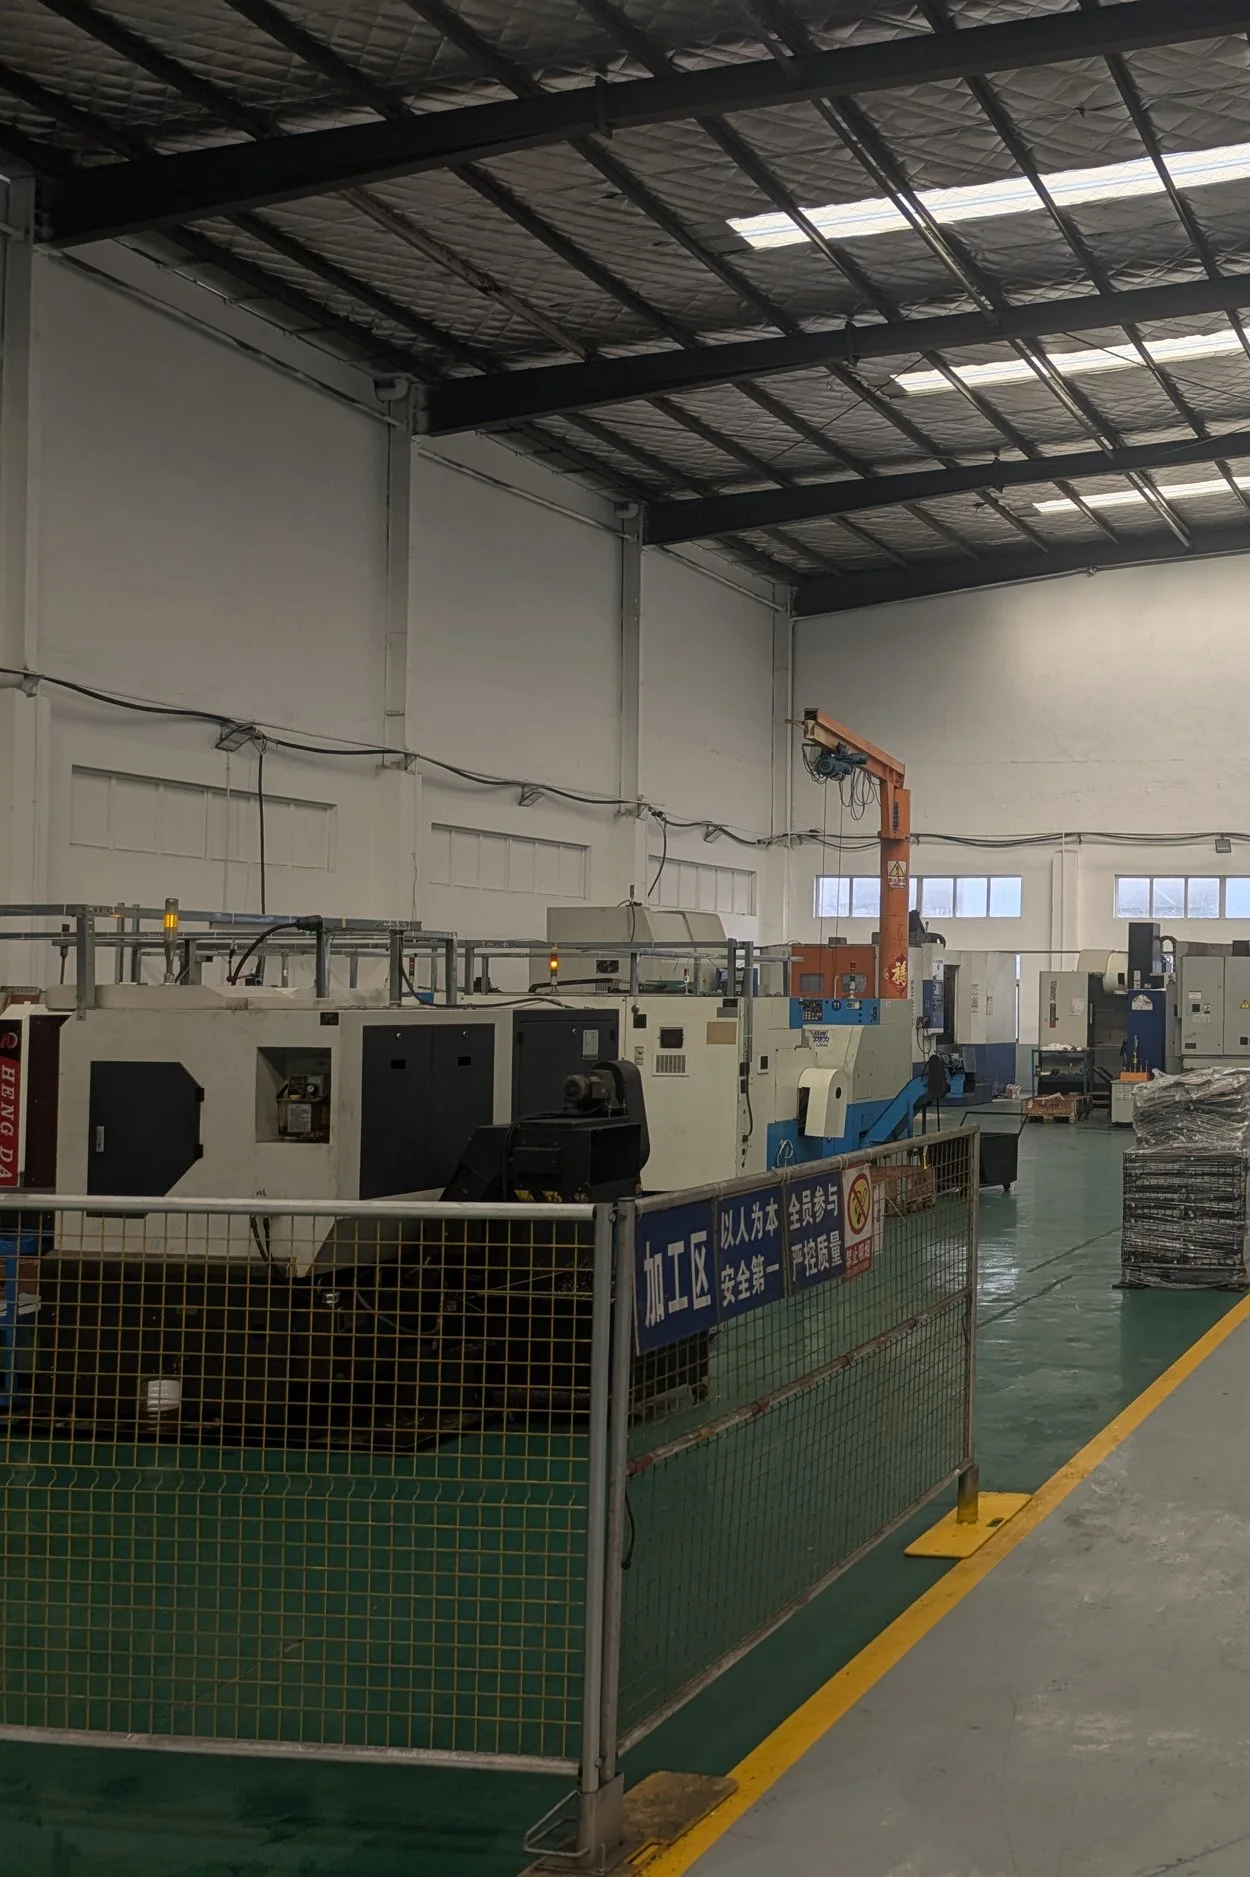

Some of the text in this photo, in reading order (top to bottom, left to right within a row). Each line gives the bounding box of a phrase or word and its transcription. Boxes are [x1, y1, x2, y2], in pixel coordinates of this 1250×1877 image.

[0, 1064, 15, 1178] HENG DA
[720, 1197, 779, 1250] 以人为本
[788, 1183, 838, 1231] 全员参与
[644, 1230, 711, 1328] 加工区
[720, 1254, 779, 1307] 安全第一
[791, 1230, 842, 1282] 严控质量
